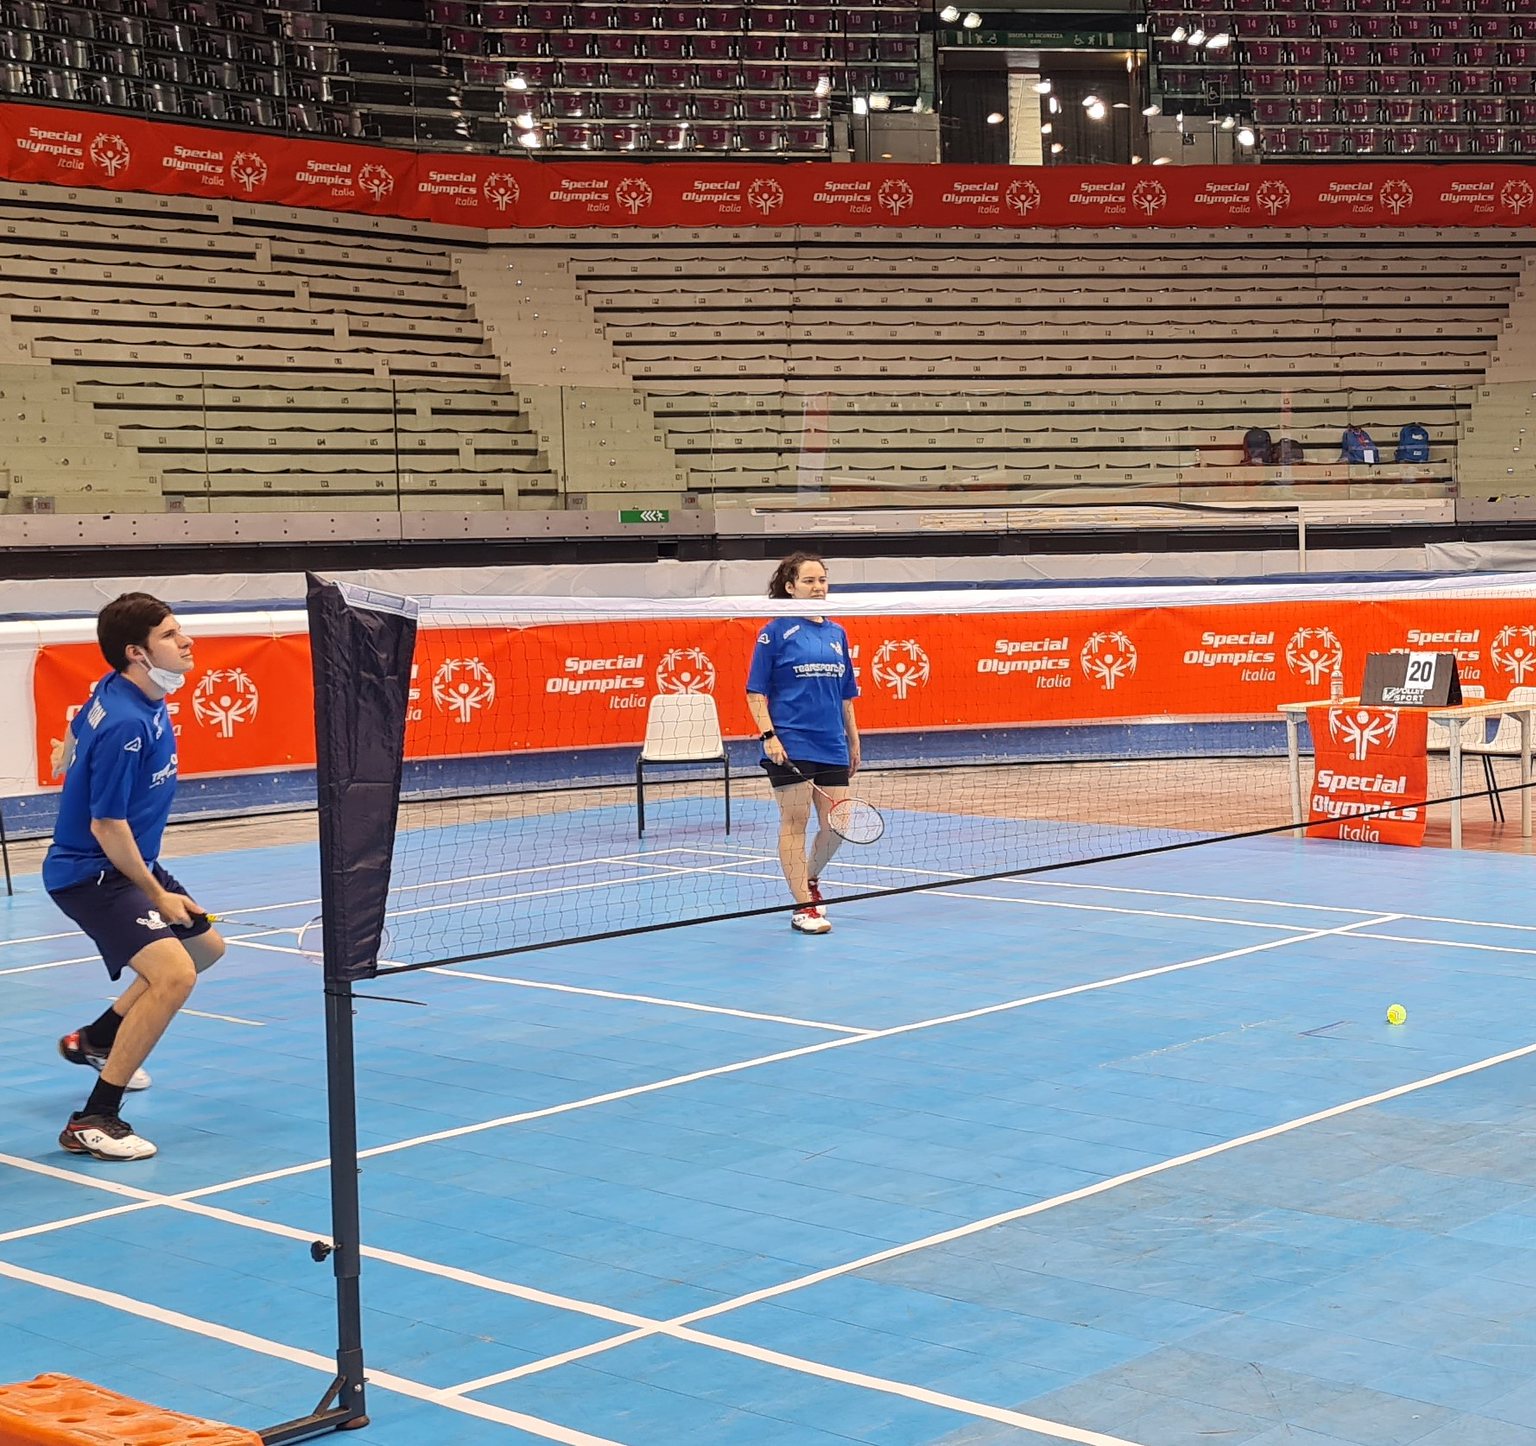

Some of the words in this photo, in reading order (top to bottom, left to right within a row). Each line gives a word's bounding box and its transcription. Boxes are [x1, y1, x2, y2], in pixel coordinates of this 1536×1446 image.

[678, 12, 685, 22] 6
[721, 12, 727, 22] 7
[1408, 20, 1418, 30] 18
[520, 37, 527, 47] 2
[615, 38, 622, 48] 4
[663, 39, 670, 49] 5
[710, 39, 717, 49] 6
[1258, 46, 1268, 56] 13
[1301, 46, 1311, 56] 14
[1345, 46, 1355, 56] 15
[1431, 47, 1441, 57] 17
[1473, 47, 1483, 57] 18
[716, 69, 723, 78] 6
[29, 126, 82, 143] Special
[16, 139, 83, 157] Olympics
[173, 145, 224, 161] Special
[162, 157, 224, 174] Olympics
[306, 159, 352, 173] Special
[295, 172, 353, 186] Olympics
[428, 170, 477, 183] Special
[418, 183, 477, 196] Olympics
[560, 179, 609, 191] Special
[693, 180, 741, 192] Special
[824, 181, 872, 192] Special
[953, 182, 999, 193] Special
[1080, 182, 1126, 193] Special
[1205, 182, 1250, 194] Special
[1329, 181, 1373, 193] Special
[1450, 181, 1495, 193] Special
[549, 191, 609, 203] Olympics
[681, 193, 741, 203] Olympics
[813, 193, 872, 204] Olympics
[942, 194, 999, 205] Olympics
[1069, 194, 1126, 205] Olympics
[1194, 194, 1250, 205] Olympics
[1318, 193, 1374, 204] Olympics
[1439, 193, 1495, 204] Olympics
[1201, 631, 1275, 649] Special
[1406, 629, 1480, 646] Special
[994, 636, 1069, 656] Special
[564, 653, 644, 675] Special
[1183, 650, 1276, 667] Olympics
[977, 657, 1070, 675] Olympics
[1408, 660, 1433, 682] 20
[1457, 664, 1481, 679] alia
[1241, 667, 1276, 682] Italia
[545, 675, 645, 695] Olympics
[1036, 673, 1072, 689] Italia
[609, 693, 647, 709] Italia
[1394, 694, 1425, 702] SPORT
[1317, 769, 1407, 794] Special
[1312, 794, 1418, 822] Olympics
[1339, 823, 1380, 843] Italia
